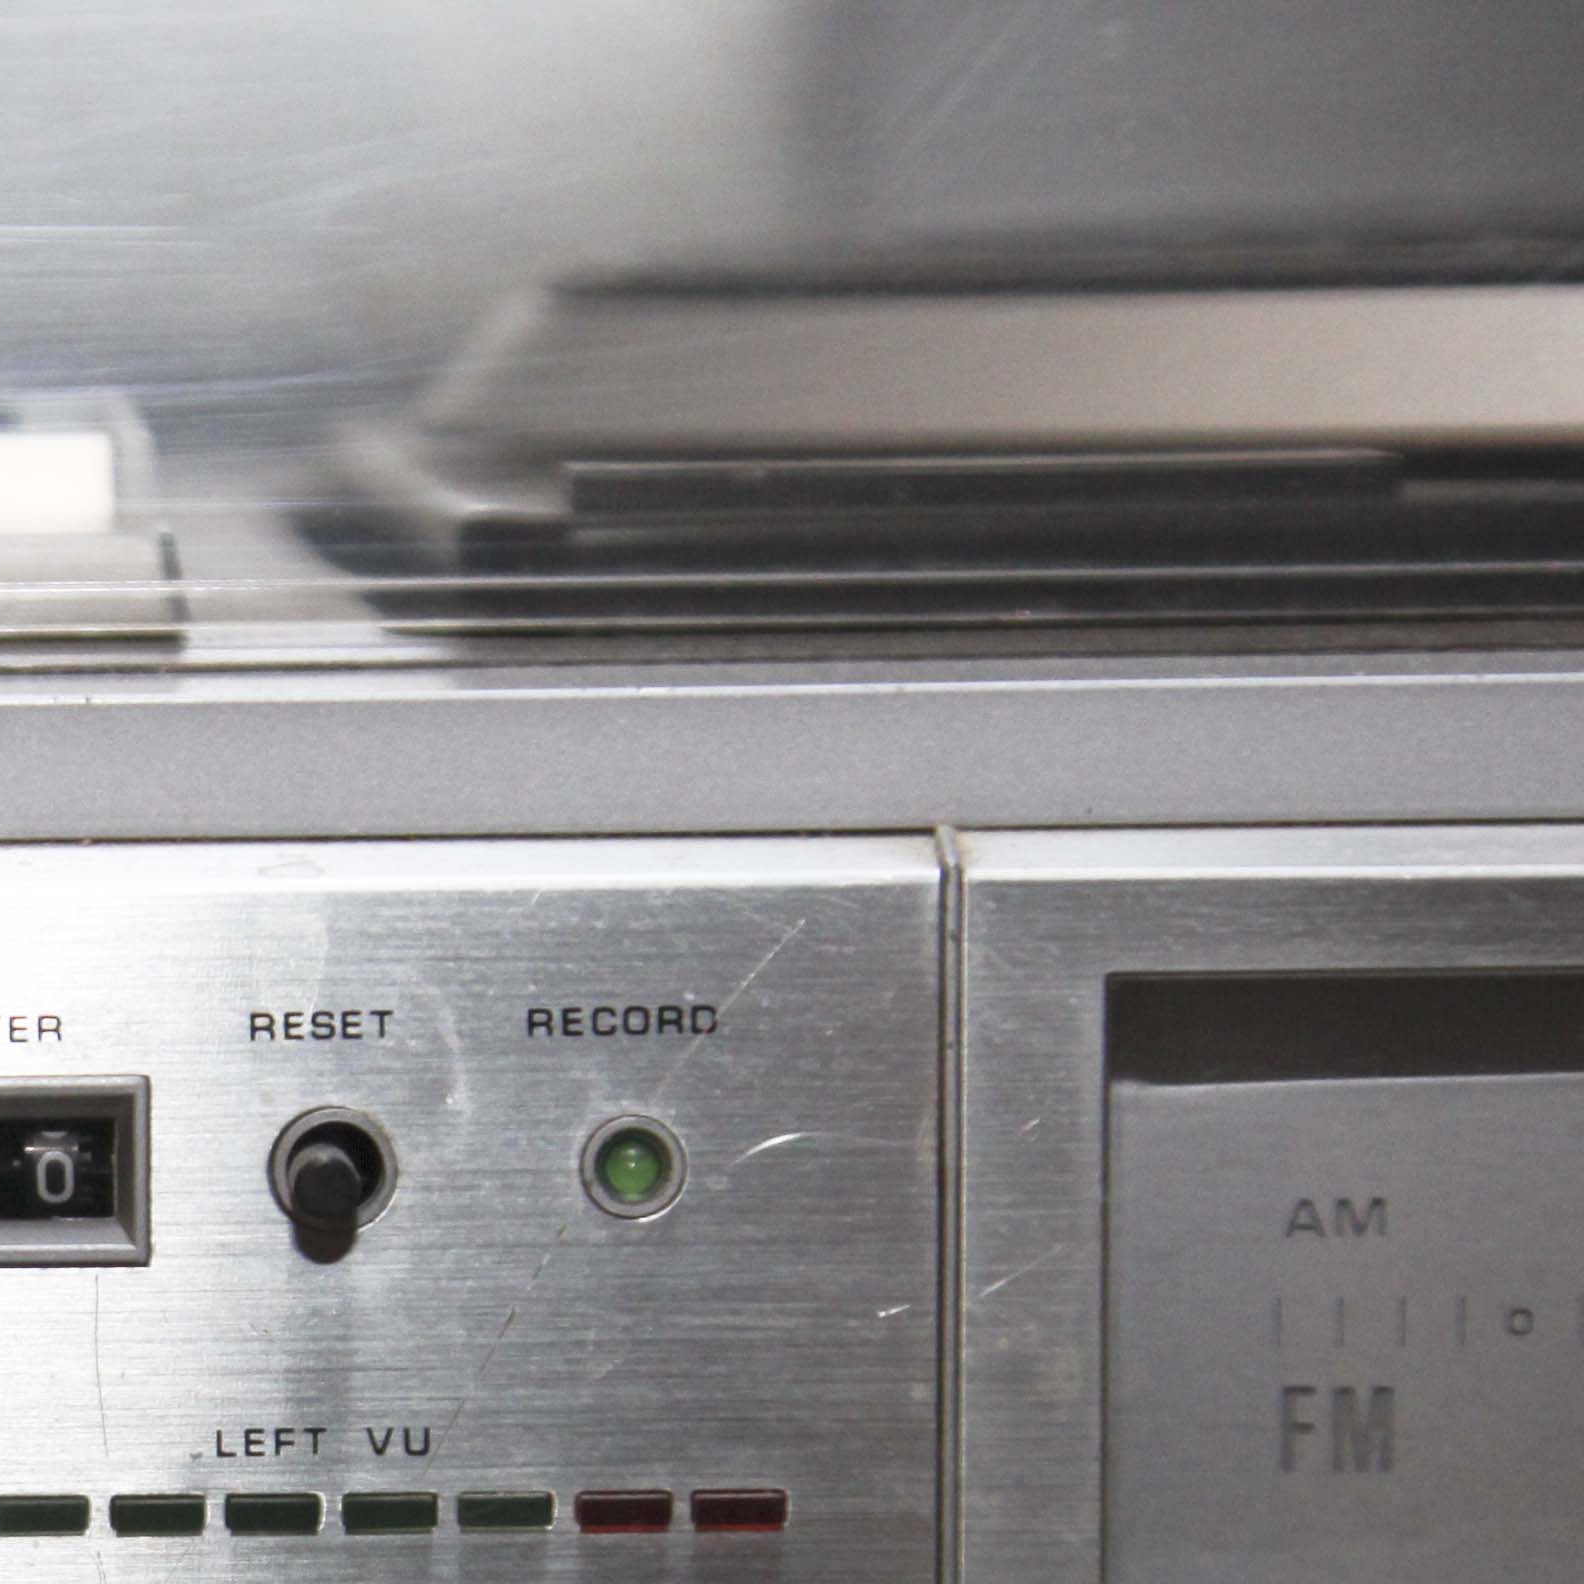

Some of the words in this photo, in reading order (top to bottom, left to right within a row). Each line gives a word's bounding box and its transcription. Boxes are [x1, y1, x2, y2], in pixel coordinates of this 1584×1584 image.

[247, 1006, 397, 1043] RESET
[525, 1002, 720, 1040] RECORD
[1283, 1196, 1391, 1240] AM
[214, 1425, 328, 1460] LEFT
[366, 1425, 432, 1458] VU
[1278, 1384, 1397, 1474] FM
